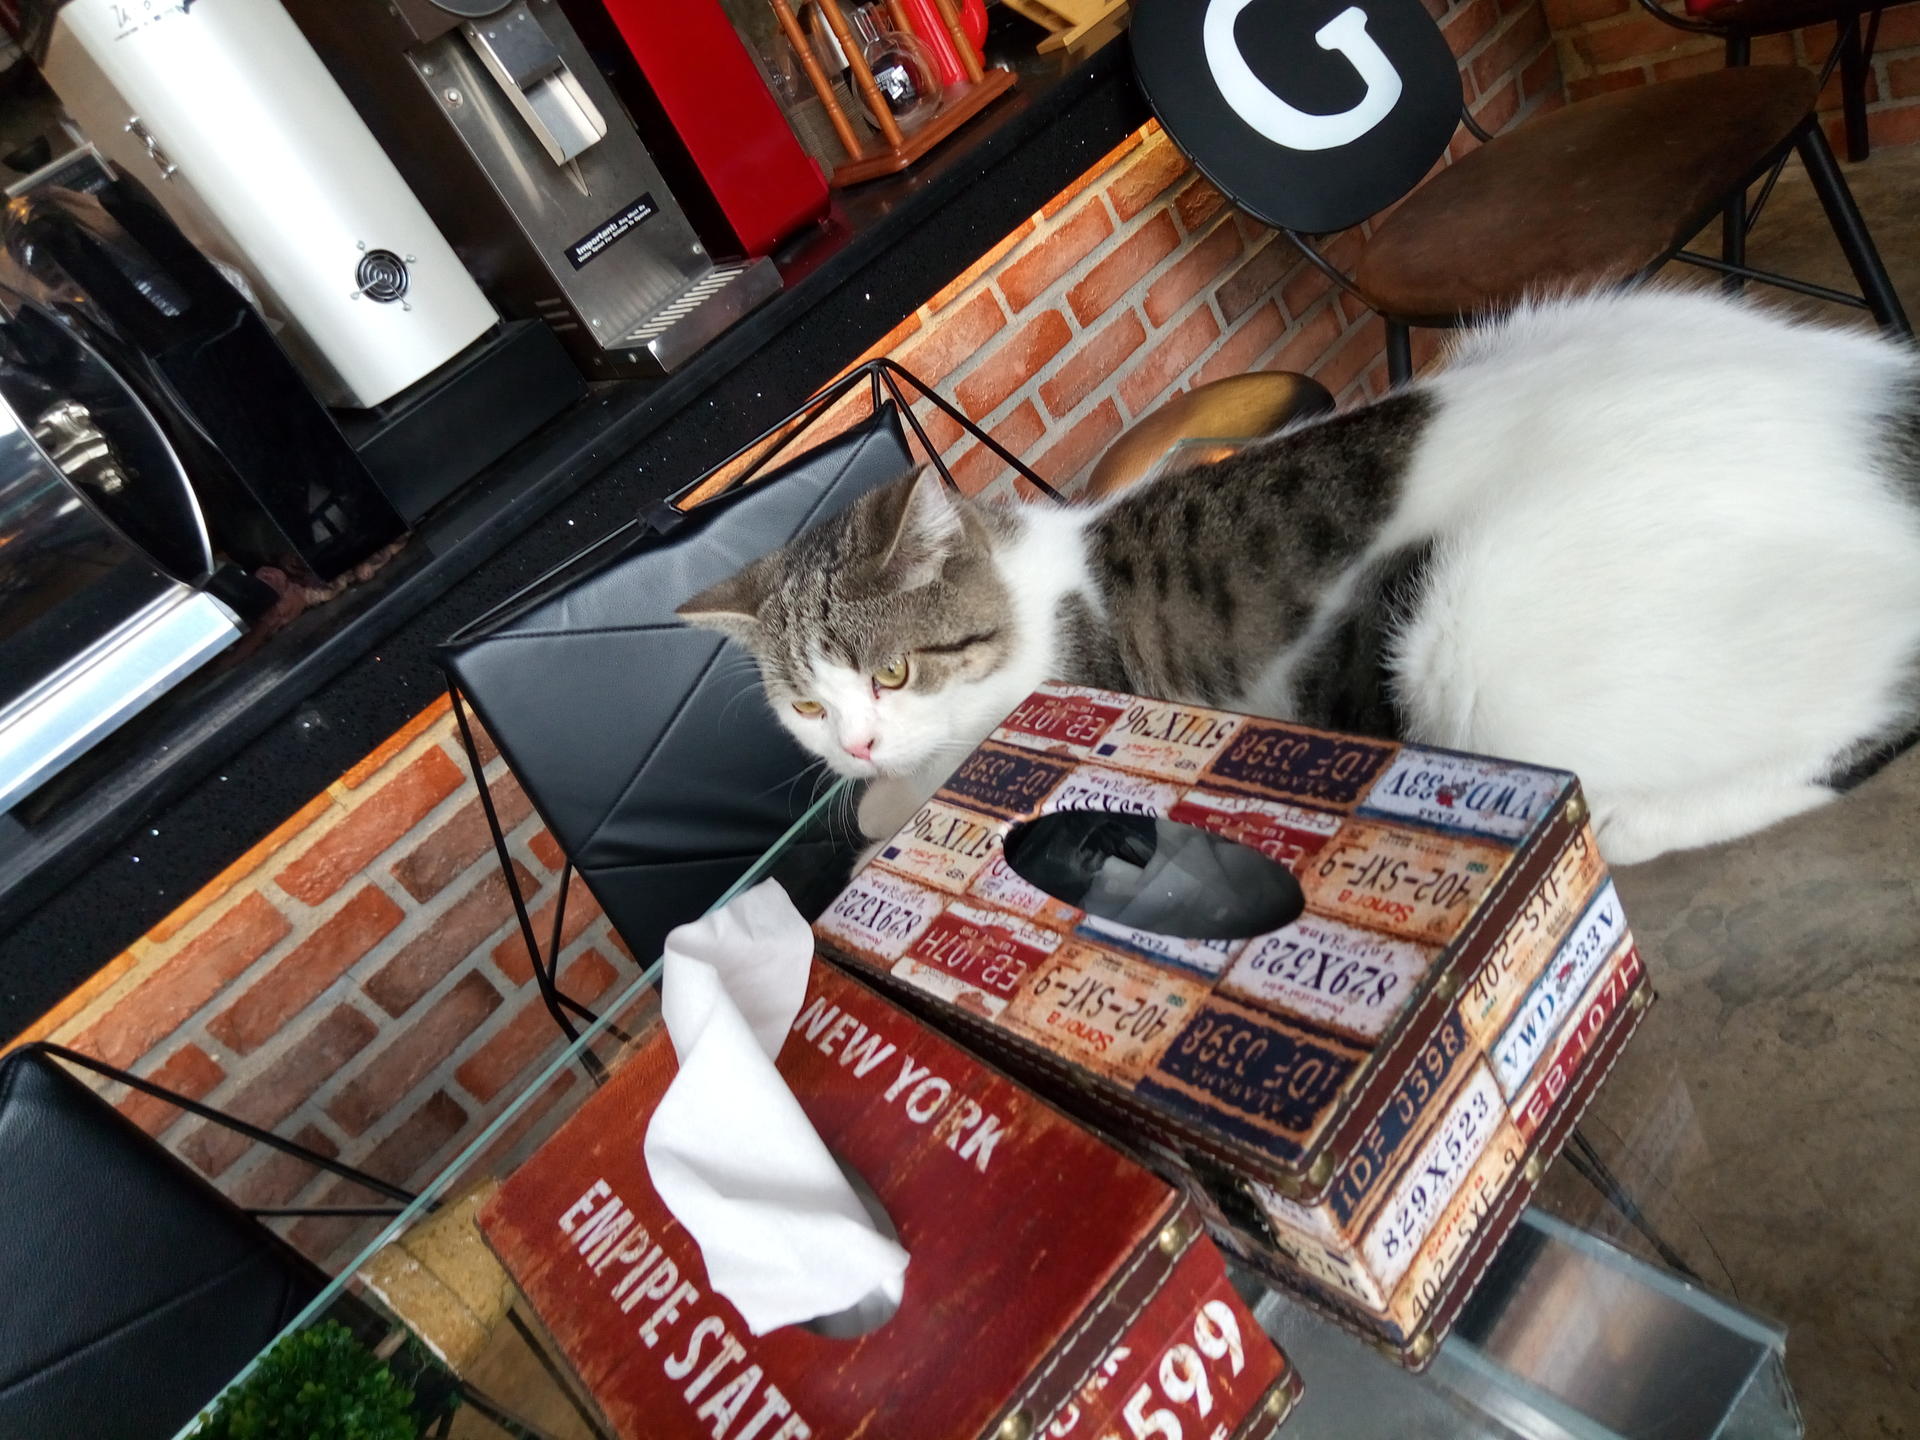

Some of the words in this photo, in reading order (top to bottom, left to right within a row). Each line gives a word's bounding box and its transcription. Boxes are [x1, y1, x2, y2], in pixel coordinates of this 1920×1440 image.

[1203, 0, 1404, 151] G
[833, 887, 921, 940] 829X523
[1249, 936, 1398, 1007] 829X523
[1500, 992, 1554, 1068] VWD
[1574, 904, 1616, 967] 33V
[791, 995, 897, 1079] NEW
[882, 1053, 1000, 1174] YORK
[1395, 1023, 1460, 1125] 0398
[1380, 1090, 1490, 1258] 829X523
